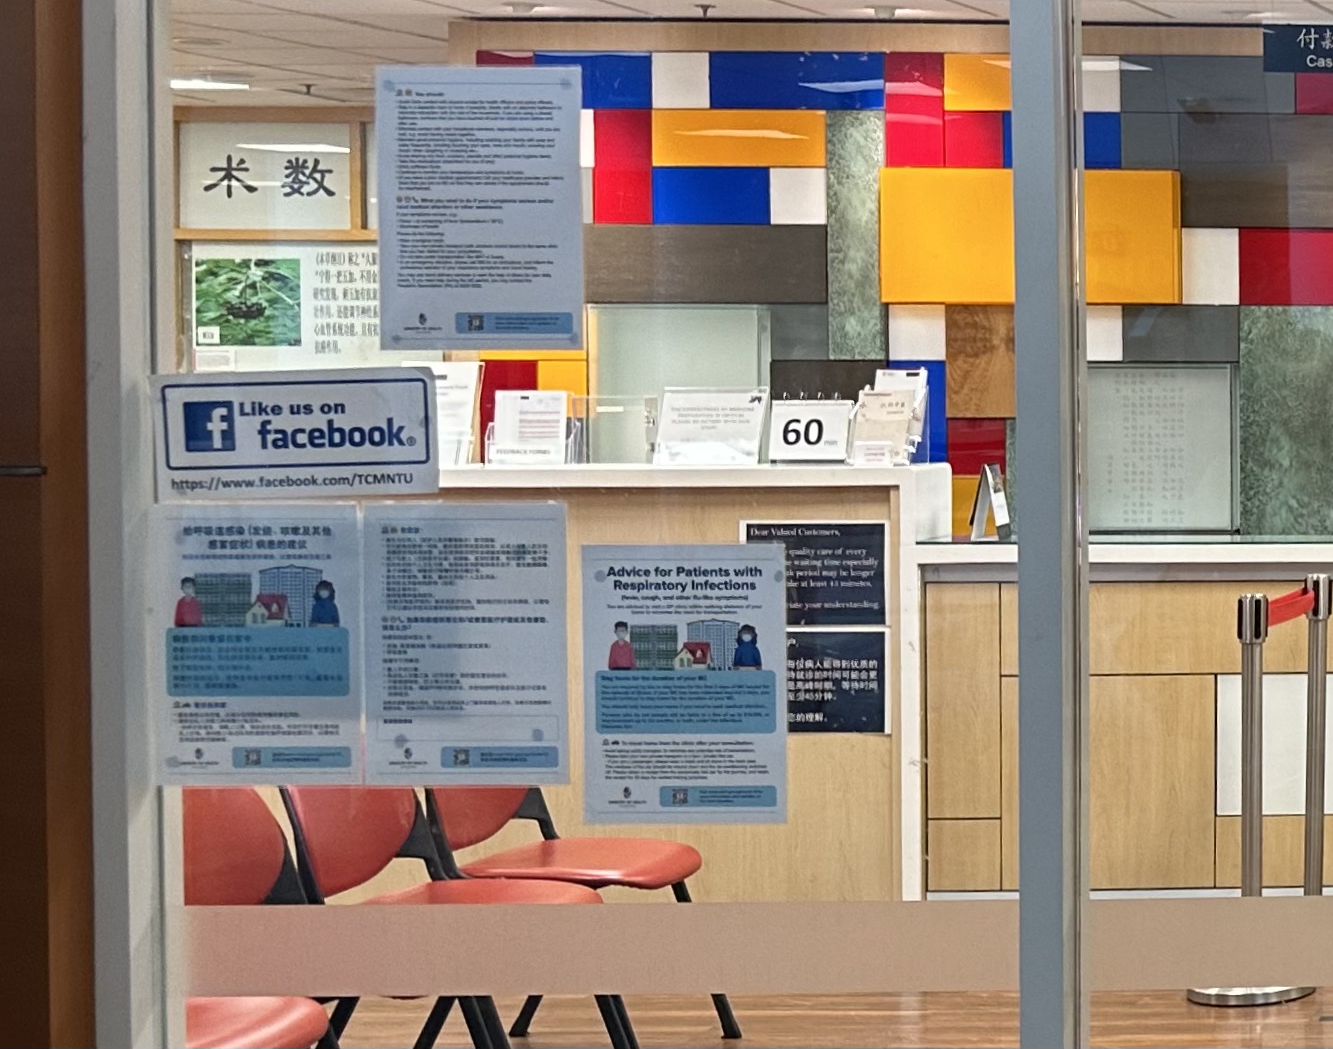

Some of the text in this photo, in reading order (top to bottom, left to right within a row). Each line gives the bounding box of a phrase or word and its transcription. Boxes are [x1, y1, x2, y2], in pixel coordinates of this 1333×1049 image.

[203, 154, 336, 198] 术数
[240, 402, 346, 416] Like us on
[782, 419, 823, 446] 60
[172, 473, 413, 492] https://www.facebook.com/TCMNTU
[798, 528, 840, 536] Customers,
[789, 547, 814, 556] quality
[843, 558, 878, 567] especially
[607, 566, 762, 577] Advice for Patients with
[851, 570, 875, 578] longer
[614, 580, 756, 592] Respiratory Infections
